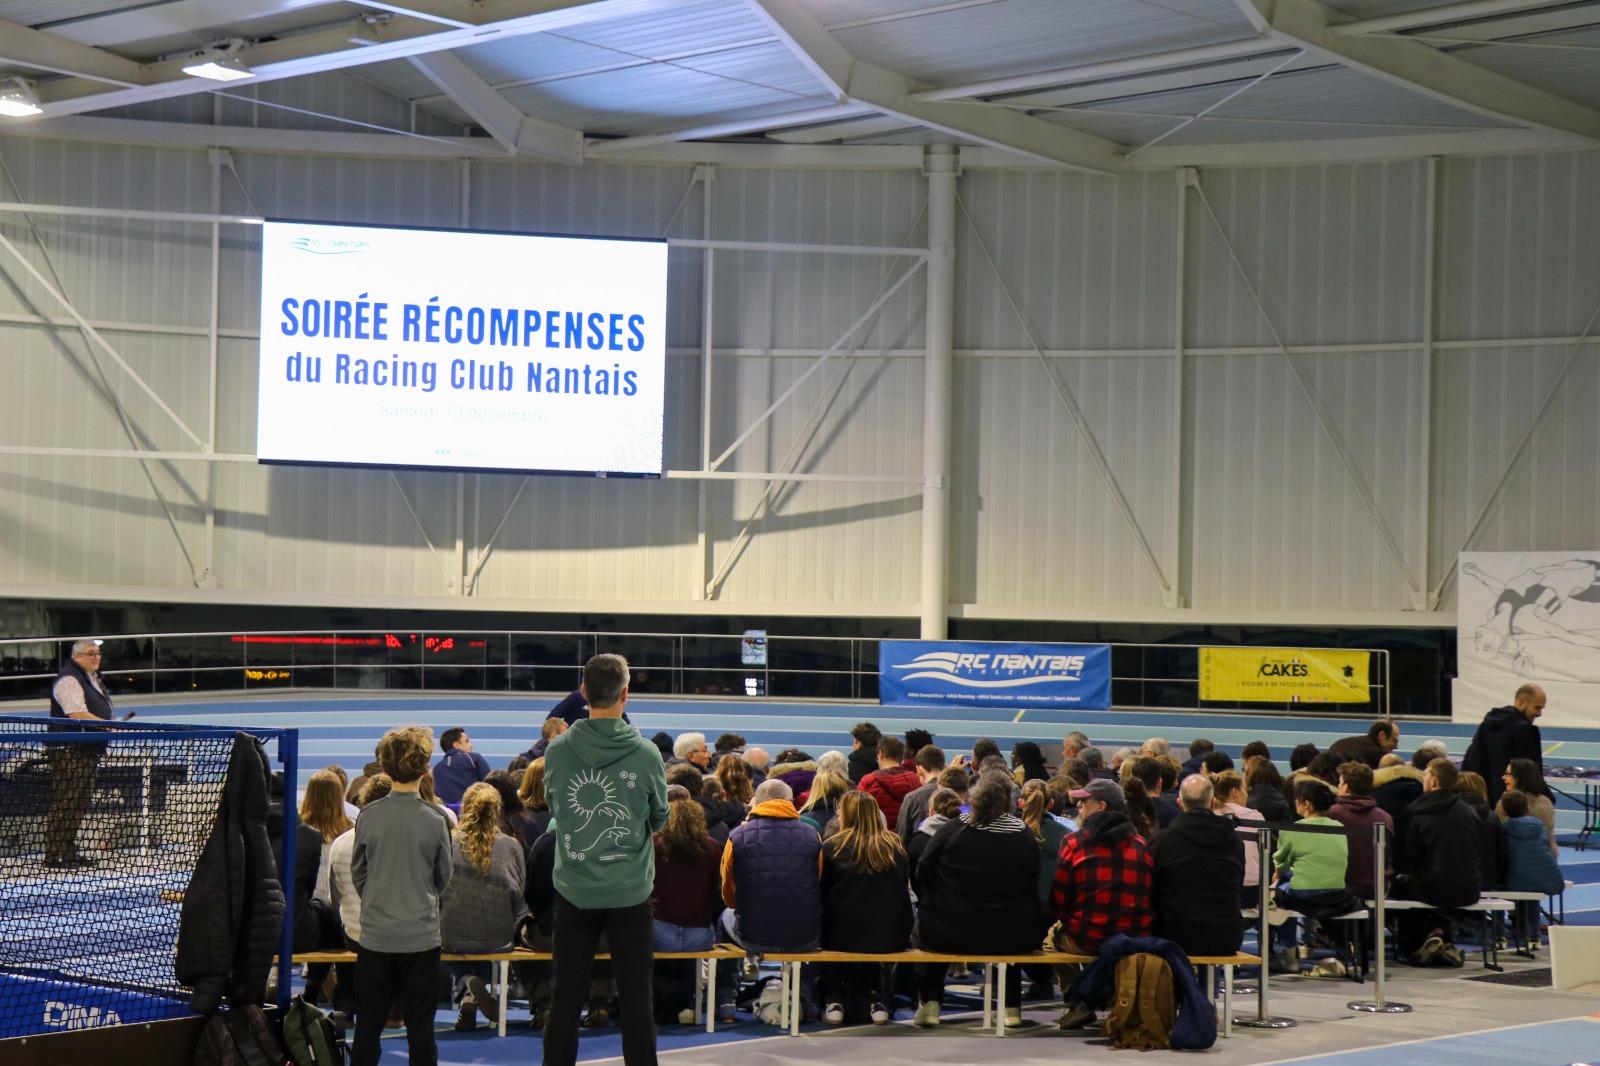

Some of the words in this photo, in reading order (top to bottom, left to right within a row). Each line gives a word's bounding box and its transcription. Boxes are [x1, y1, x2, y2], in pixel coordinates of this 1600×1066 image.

[281, 292, 388, 340] SOIRÉE
[402, 296, 645, 351] RÉCOMPENSES
[286, 351, 321, 383] du
[335, 353, 437, 392] Racing
[450, 359, 513, 391] Club
[527, 361, 638, 396] Nantais
[379, 403, 440, 418] Samedi
[447, 405, 464, 419] 13
[956, 653, 991, 669] RC
[1261, 664, 1308, 676] CAKES
[44, 1000, 122, 1030] DIMA
